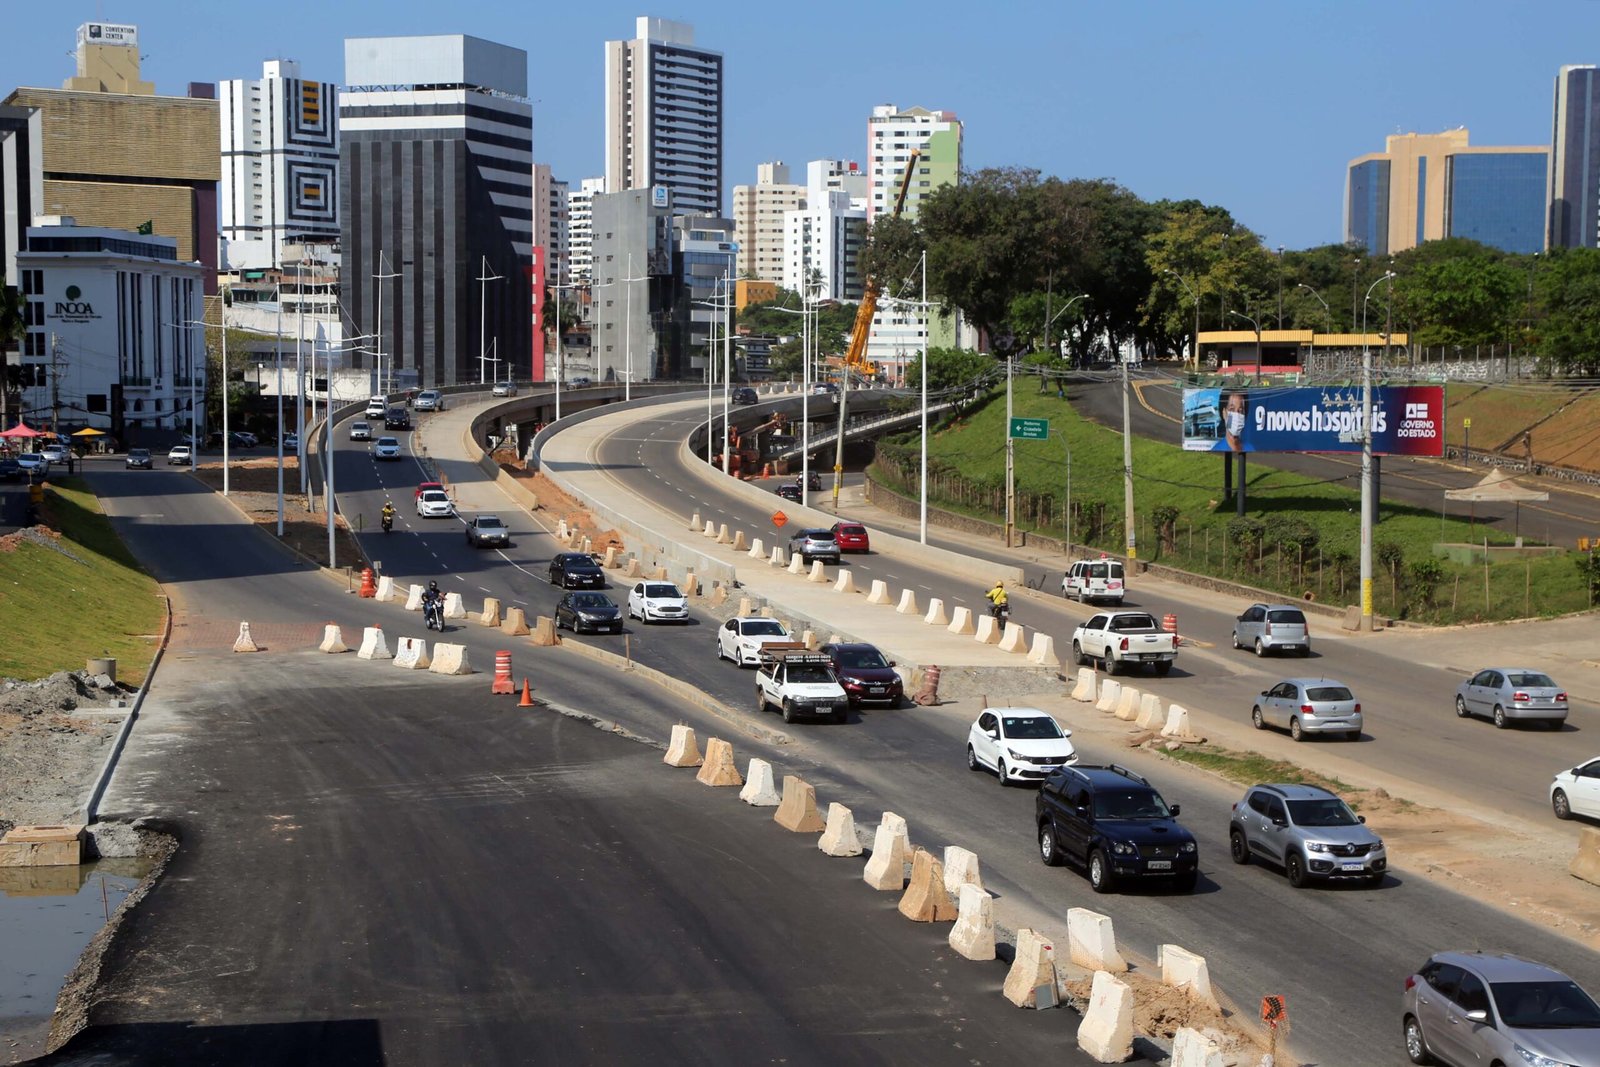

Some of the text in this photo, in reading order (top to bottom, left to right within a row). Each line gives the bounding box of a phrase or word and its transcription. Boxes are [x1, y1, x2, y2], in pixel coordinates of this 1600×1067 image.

[1255, 405, 1387, 435] 9 novos hospitis
[1400, 420, 1434, 429] GOVERNO
[1398, 429, 1436, 438] DO ESTADO
